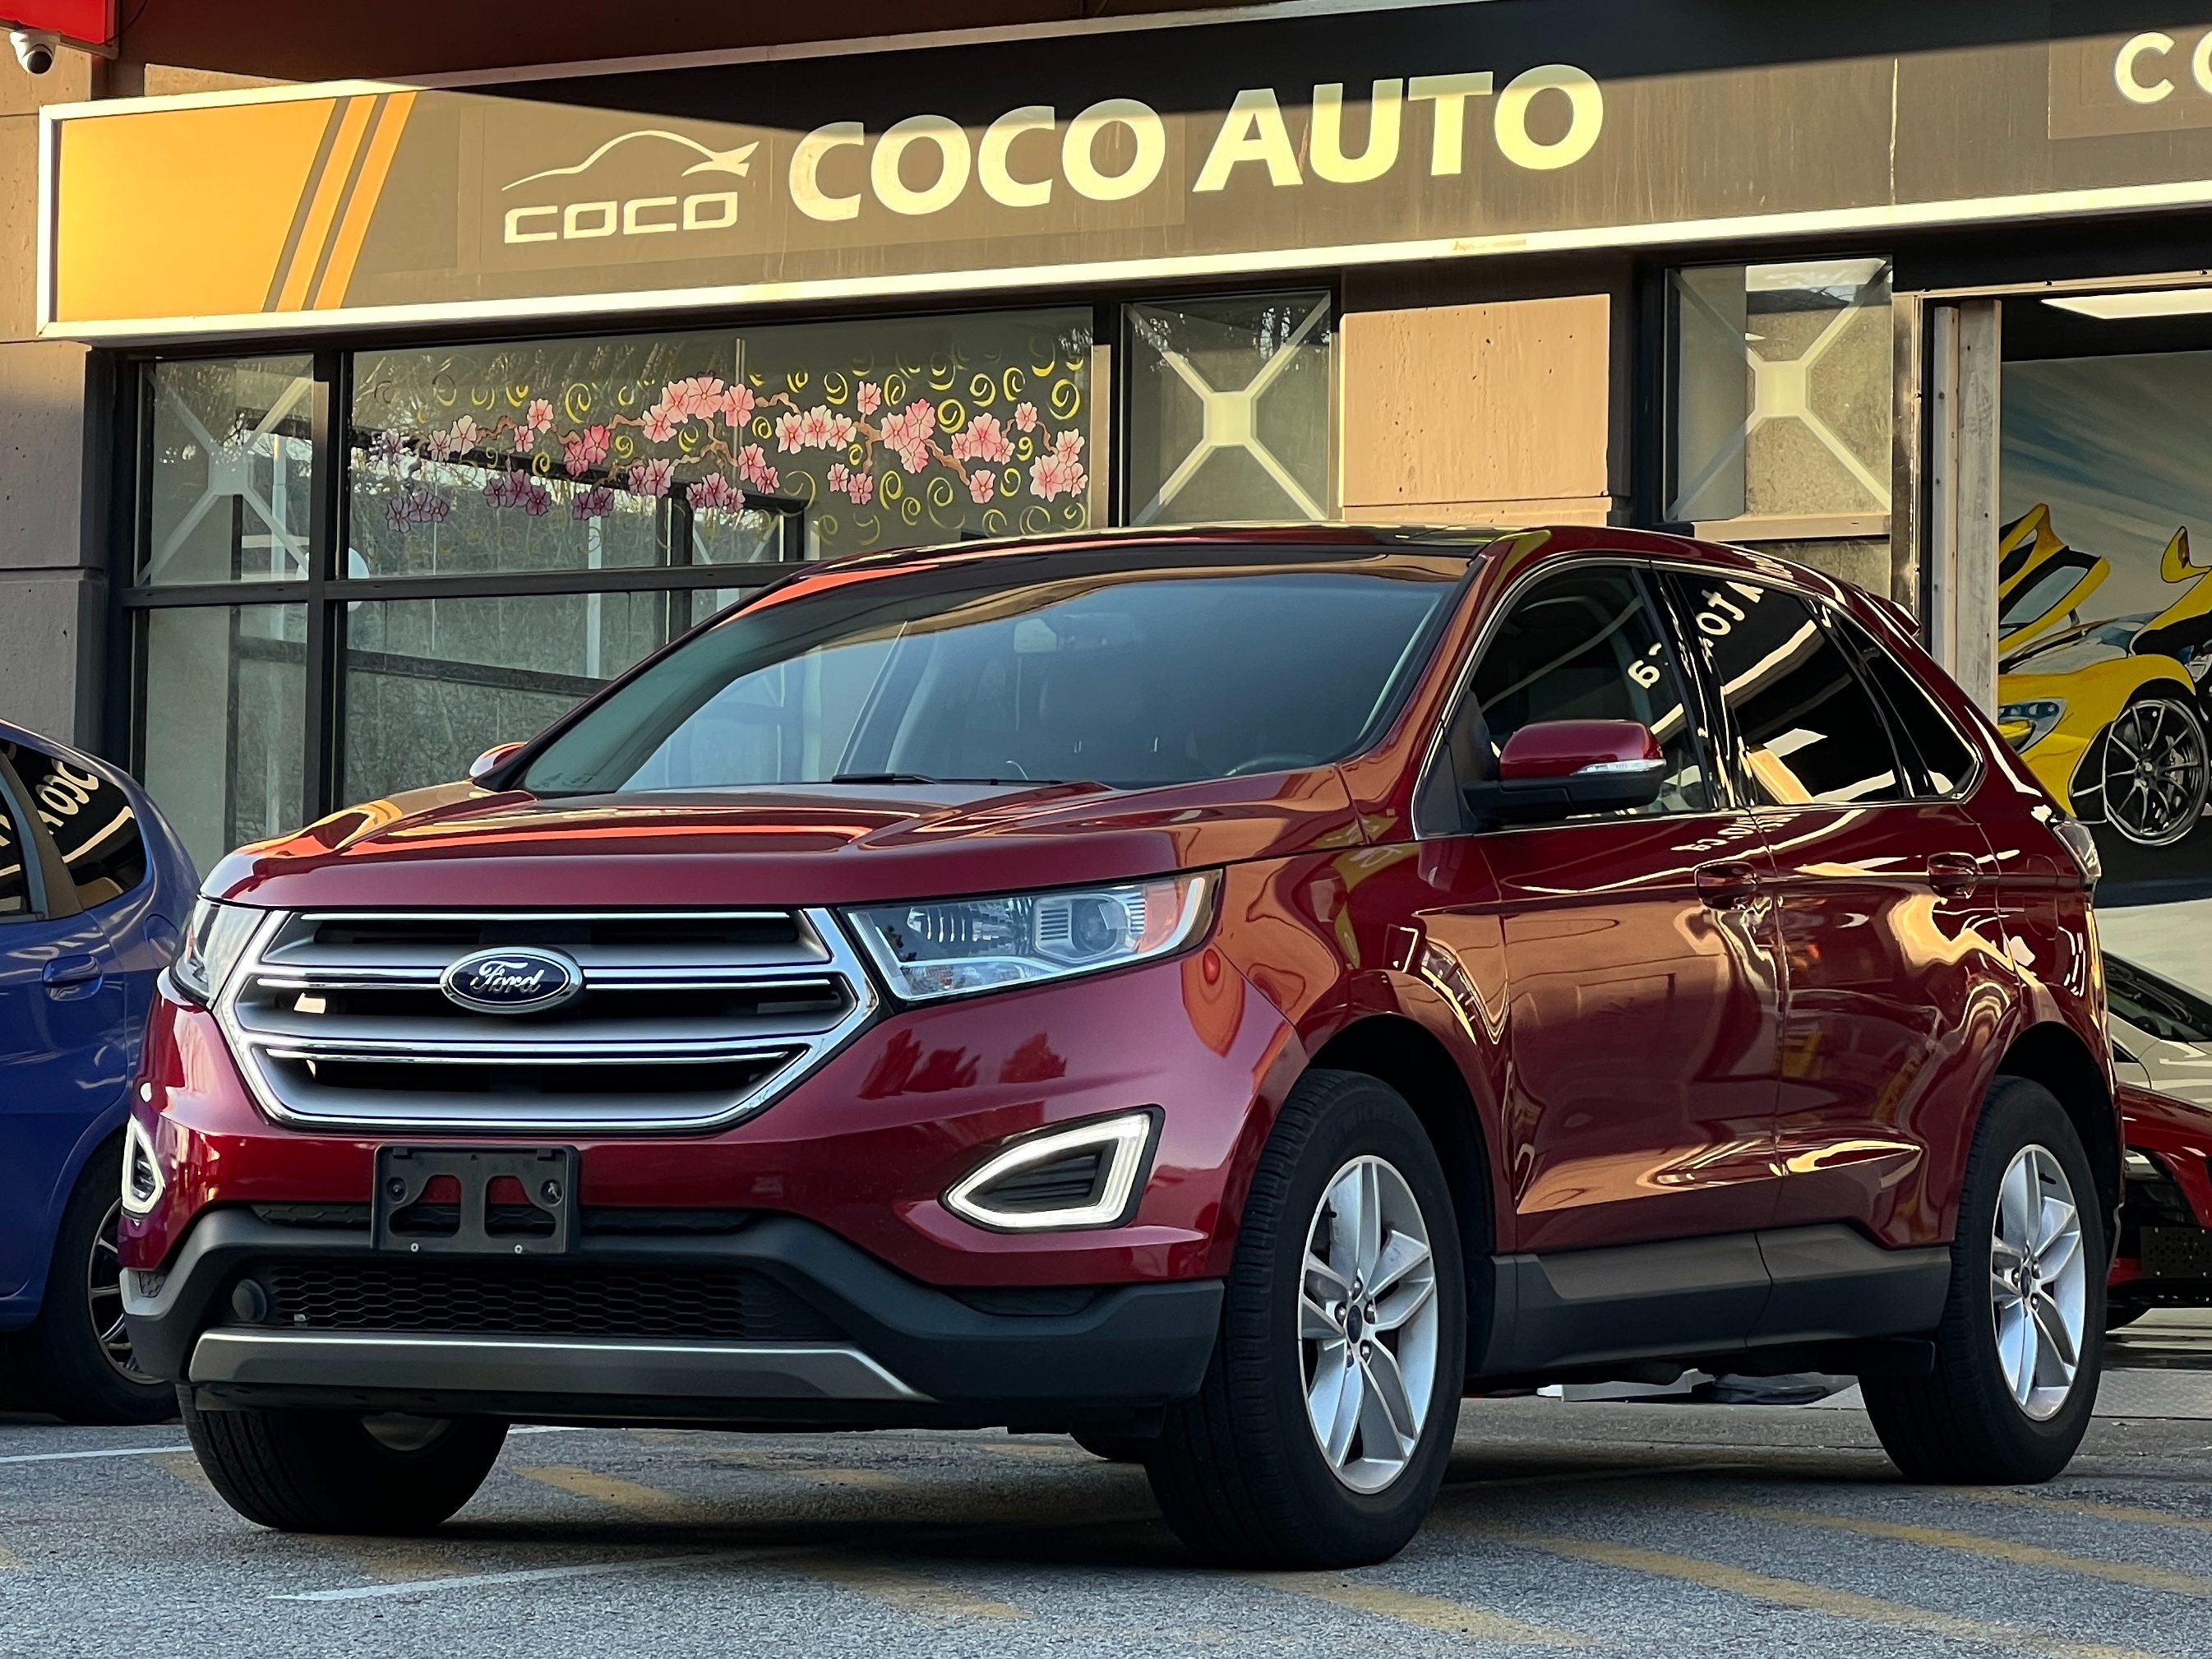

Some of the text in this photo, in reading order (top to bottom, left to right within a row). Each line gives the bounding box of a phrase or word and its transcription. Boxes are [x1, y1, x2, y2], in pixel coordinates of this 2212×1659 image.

[2114, 30, 2212, 104] C
[788, 64, 1605, 221] COCO AUTO
[504, 192, 738, 244] COCO
[470, 960, 544, 994] Ford
